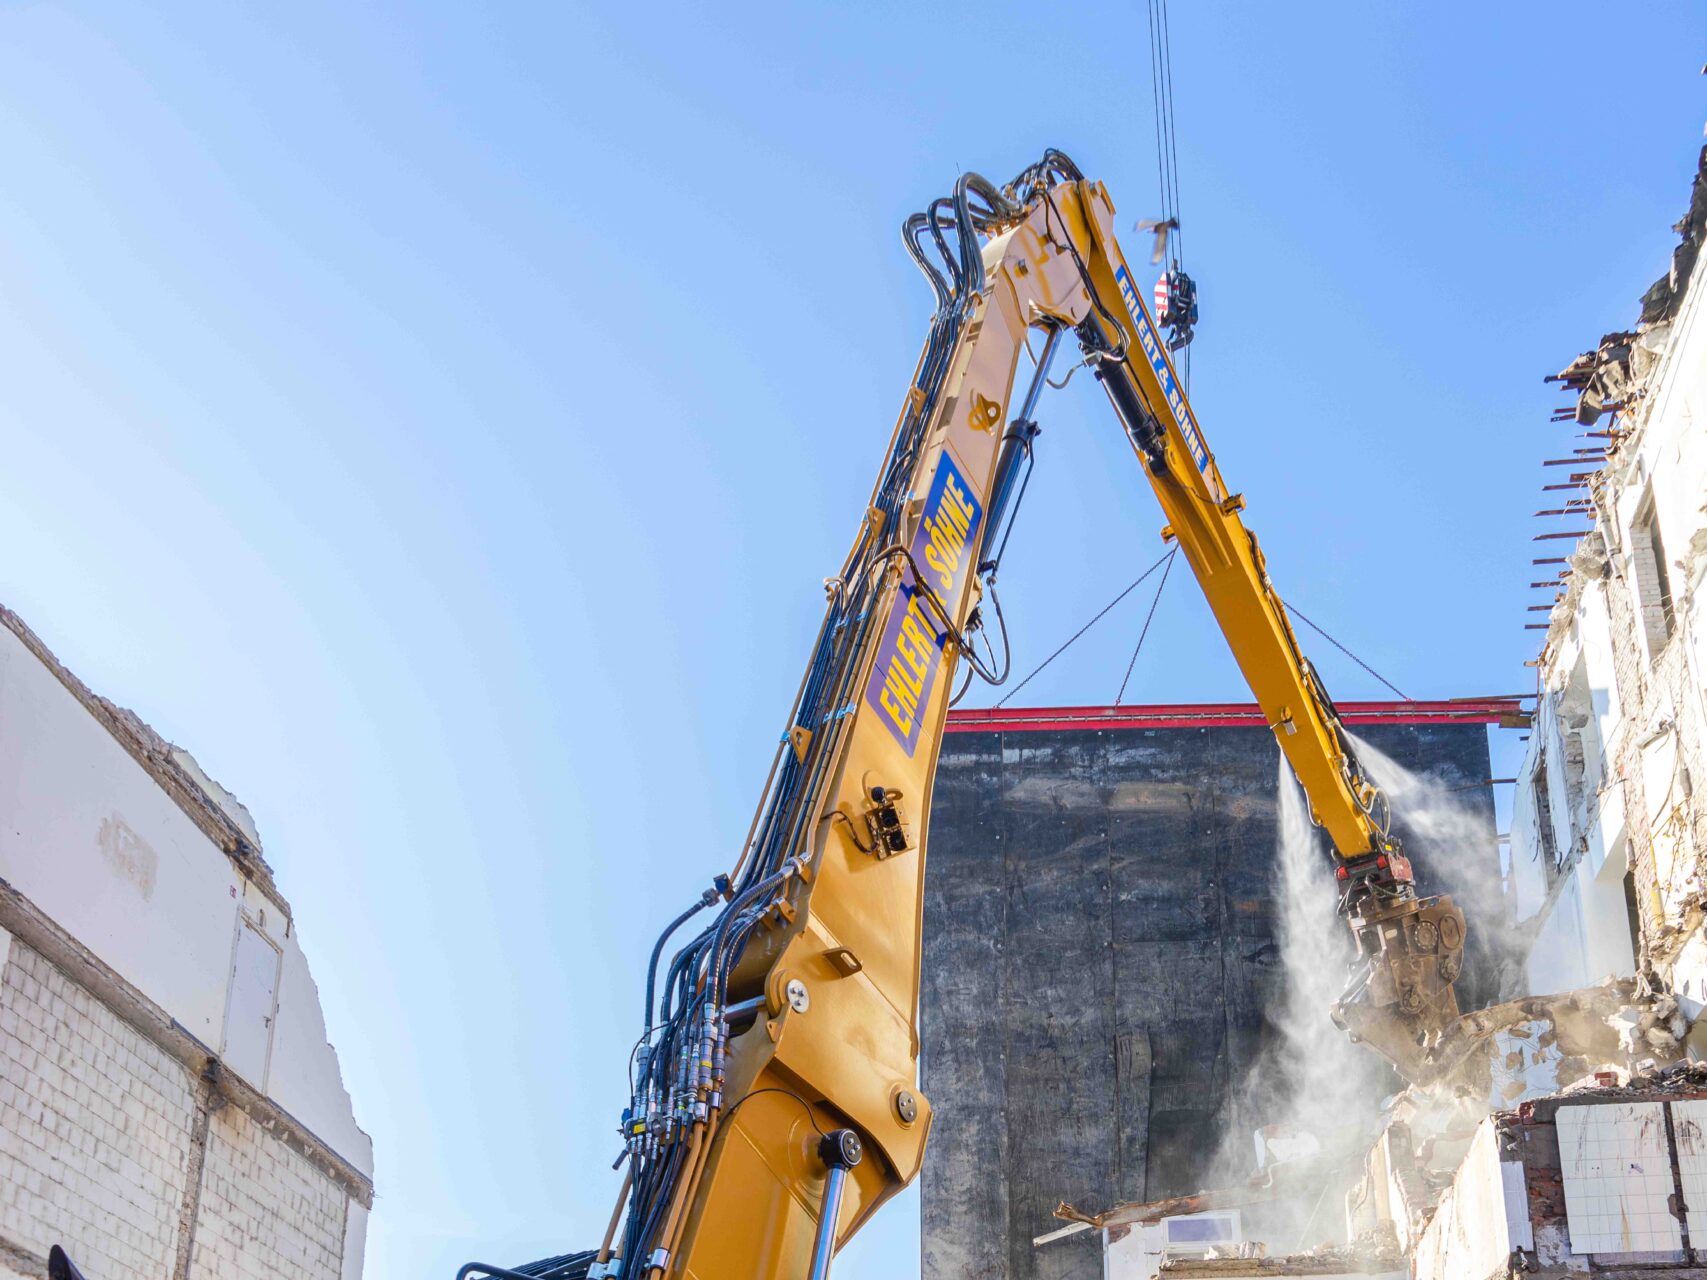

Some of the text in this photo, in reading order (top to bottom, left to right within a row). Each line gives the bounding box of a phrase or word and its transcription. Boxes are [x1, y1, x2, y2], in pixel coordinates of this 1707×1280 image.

[1118, 276, 1205, 467] EHLERT & SÖHNE
[880, 593, 938, 738] EHLERT
[924, 472, 974, 590] SÖHNE
